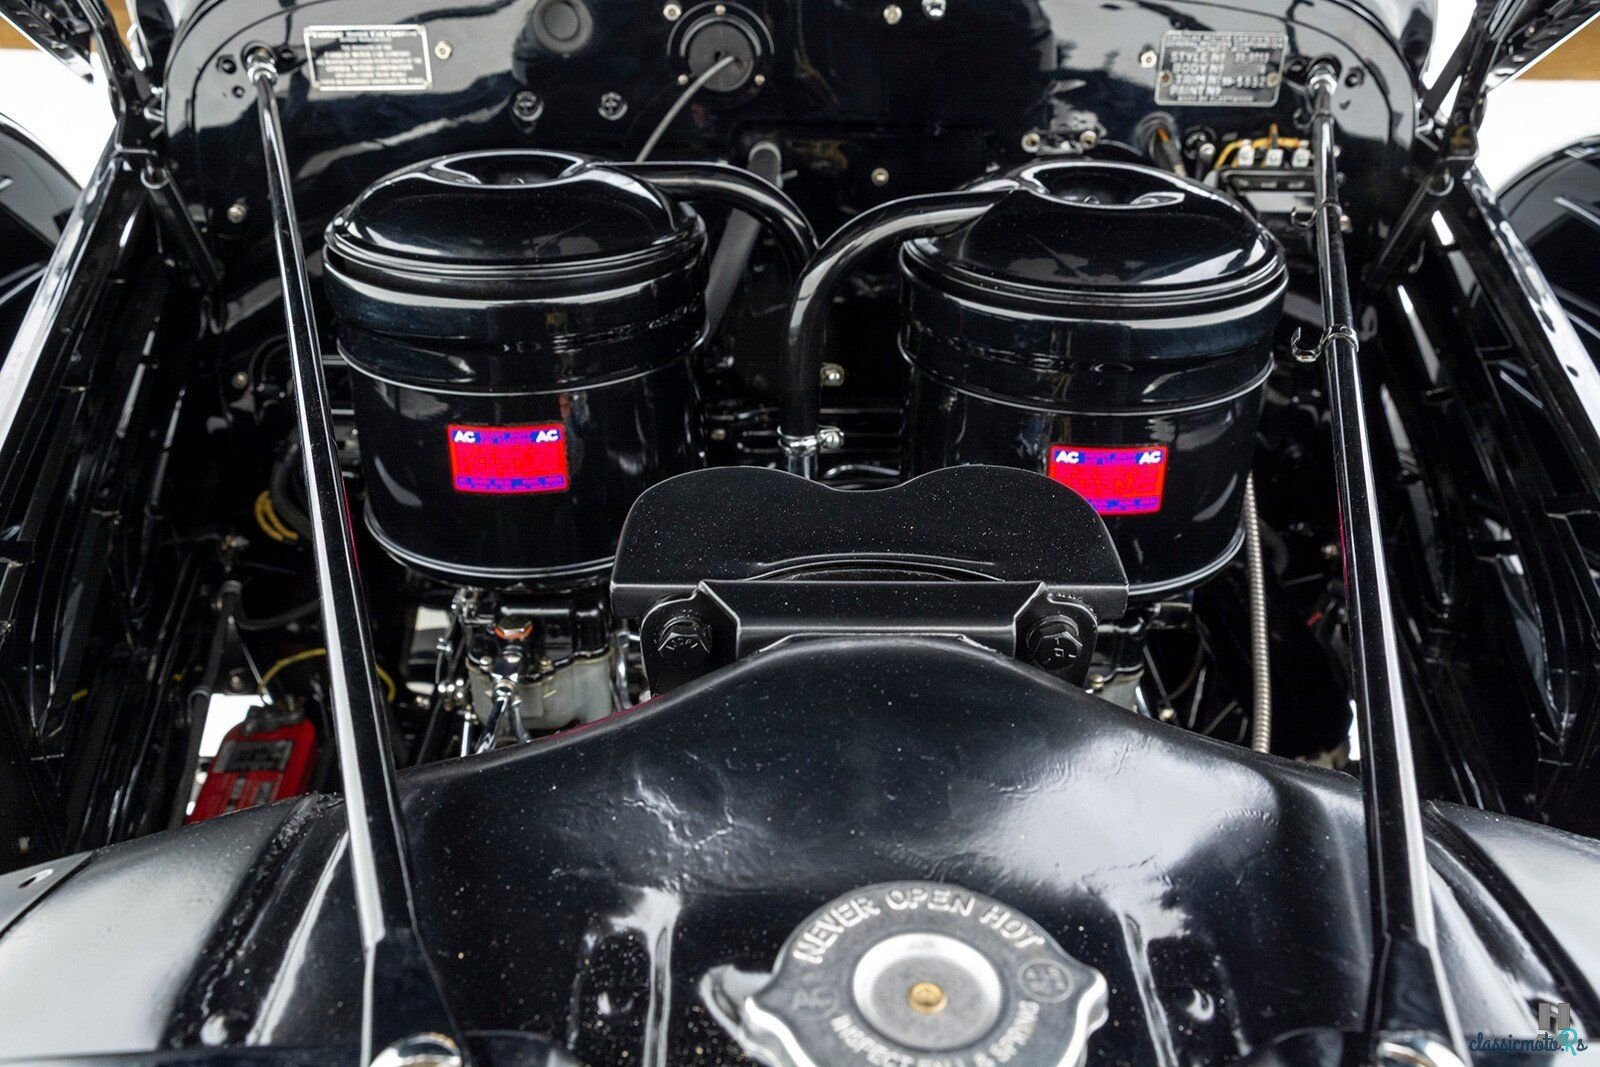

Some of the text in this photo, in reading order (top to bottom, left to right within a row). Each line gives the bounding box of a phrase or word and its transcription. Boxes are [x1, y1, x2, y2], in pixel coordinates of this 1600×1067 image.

[454, 430, 476, 443] AC
[536, 430, 559, 443] AC
[1056, 450, 1080, 464] AC
[1138, 450, 1162, 465] AC
[793, 888, 1046, 964] NEVER OPEN HOT
